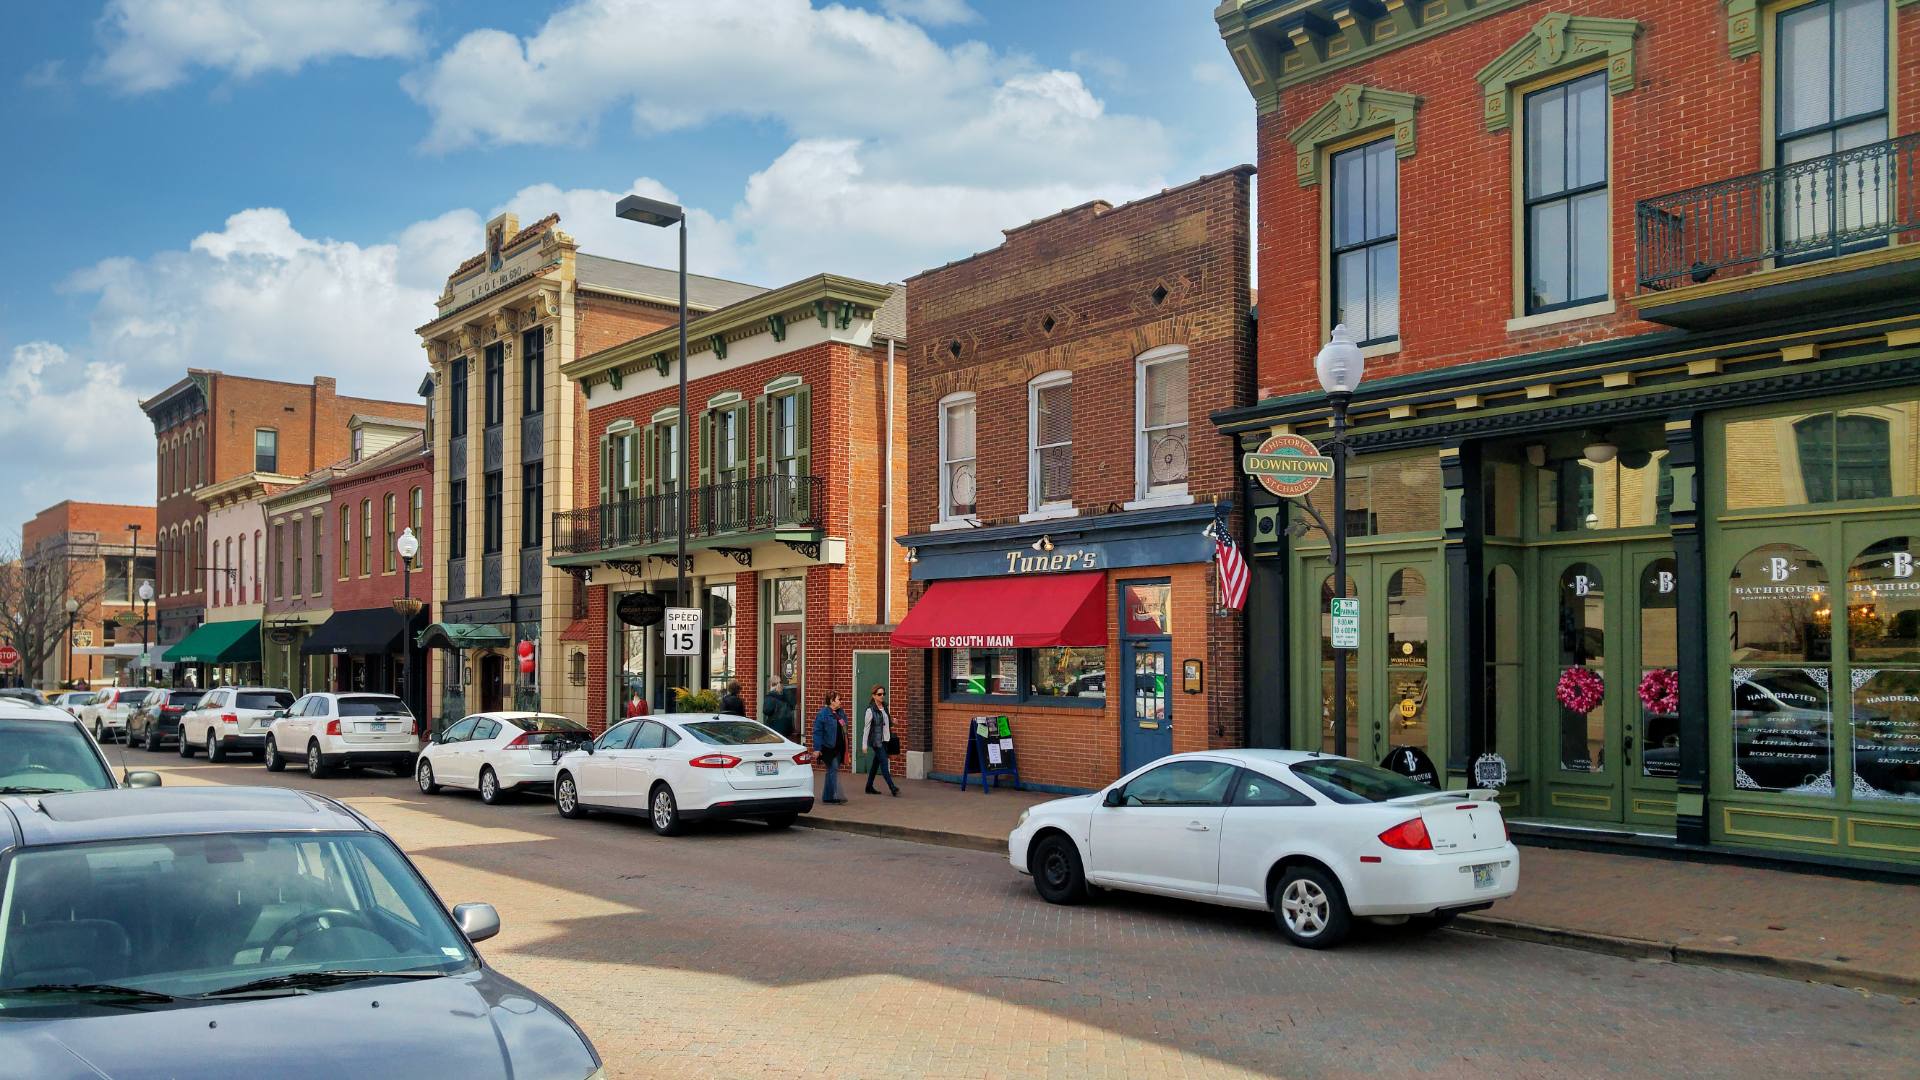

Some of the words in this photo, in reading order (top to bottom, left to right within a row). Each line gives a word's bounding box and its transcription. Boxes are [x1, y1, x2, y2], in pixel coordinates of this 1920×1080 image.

[1268, 438, 1310, 452] HISTORIC
[1249, 457, 1329, 473] DOWNTOWN
[1276, 478, 1313, 493] CHARLES
[1006, 549, 1097, 574] Tuner's
[1735, 585, 1826, 594] BATHHOUSE
[1333, 601, 1340, 615] 2
[668, 613, 699, 622] SPEED
[671, 623, 696, 631] LIMIT
[672, 633, 694, 651] 15
[930, 636, 947, 648] 130
[949, 635, 984, 647] SOUTH
[986, 635, 1014, 647] MAIN
[1747, 692, 1817, 703] HANDCRAFTED
[1776, 752, 1818, 760] BUTTER
[1877, 757, 1904, 765] SKIN
